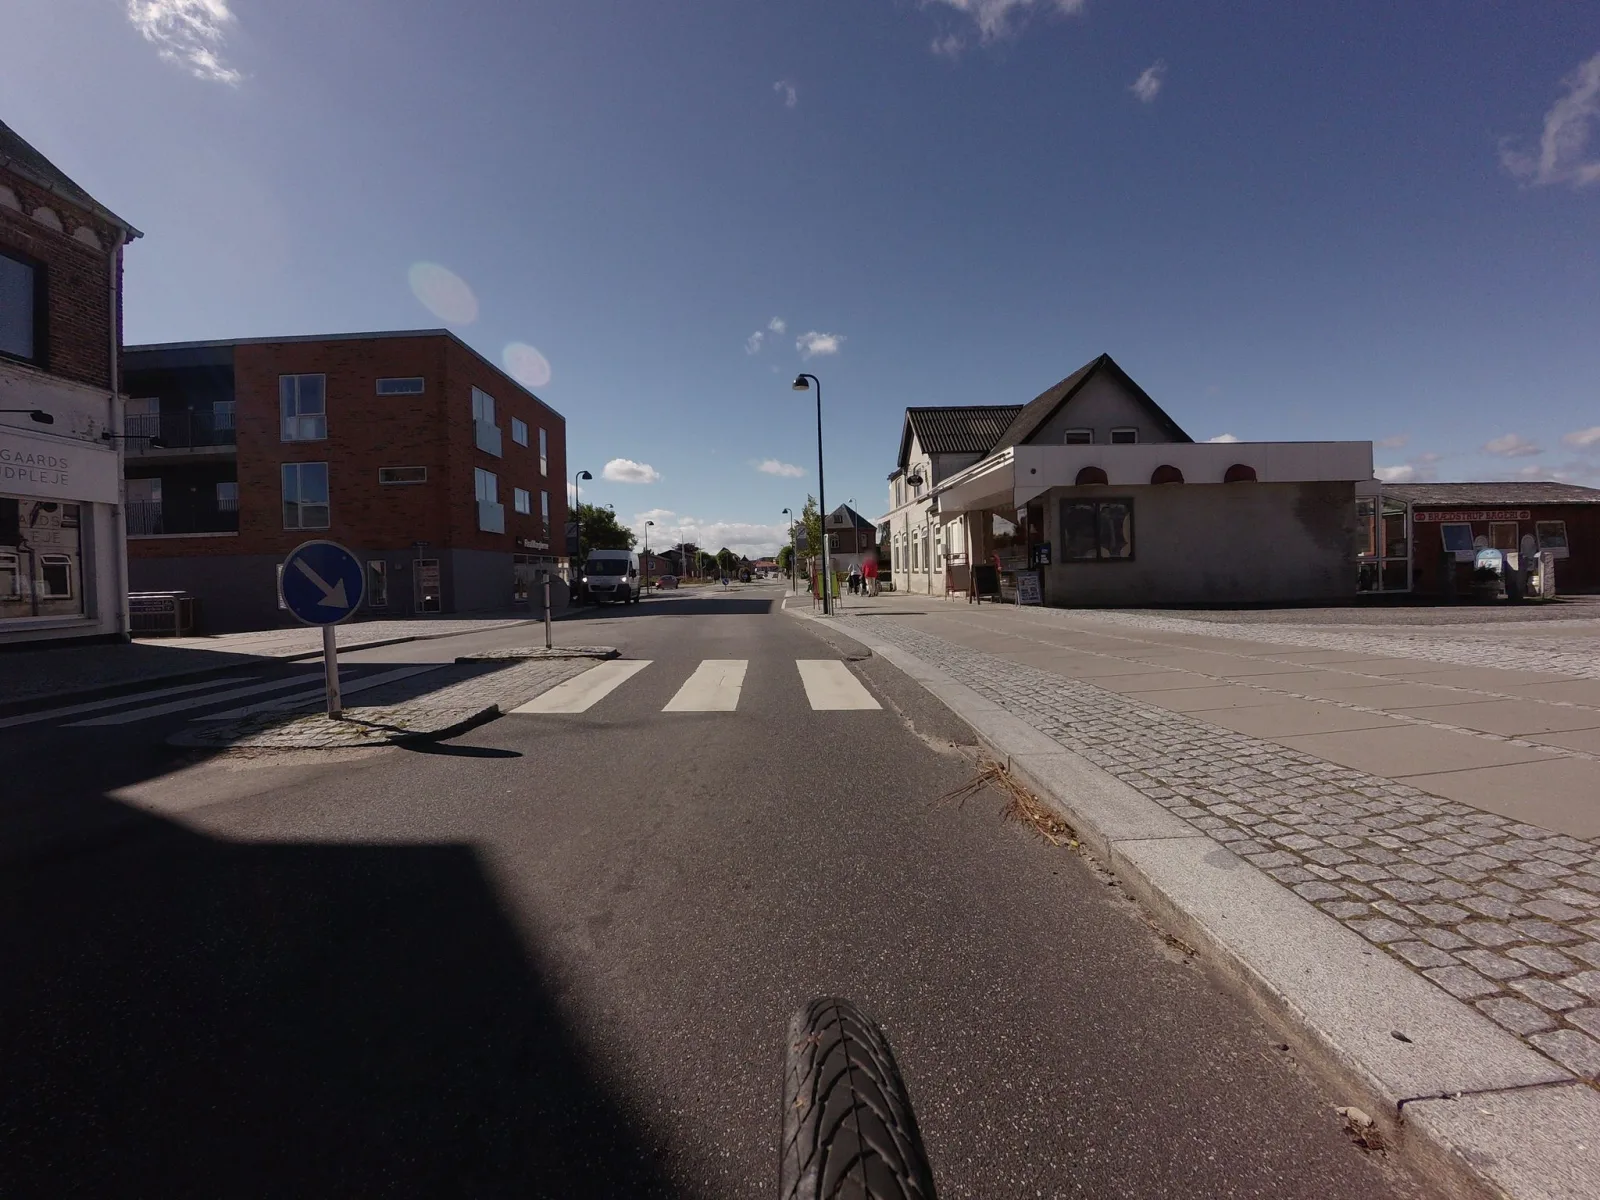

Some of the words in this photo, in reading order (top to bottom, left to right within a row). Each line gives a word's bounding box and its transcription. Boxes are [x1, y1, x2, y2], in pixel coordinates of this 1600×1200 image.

[0, 449, 68, 469] GAARDS
[0, 466, 68, 486] DPLEJE
[1428, 511, 1484, 521] BRÆDSTRUP
[1486, 510, 1518, 520] BAGERI
